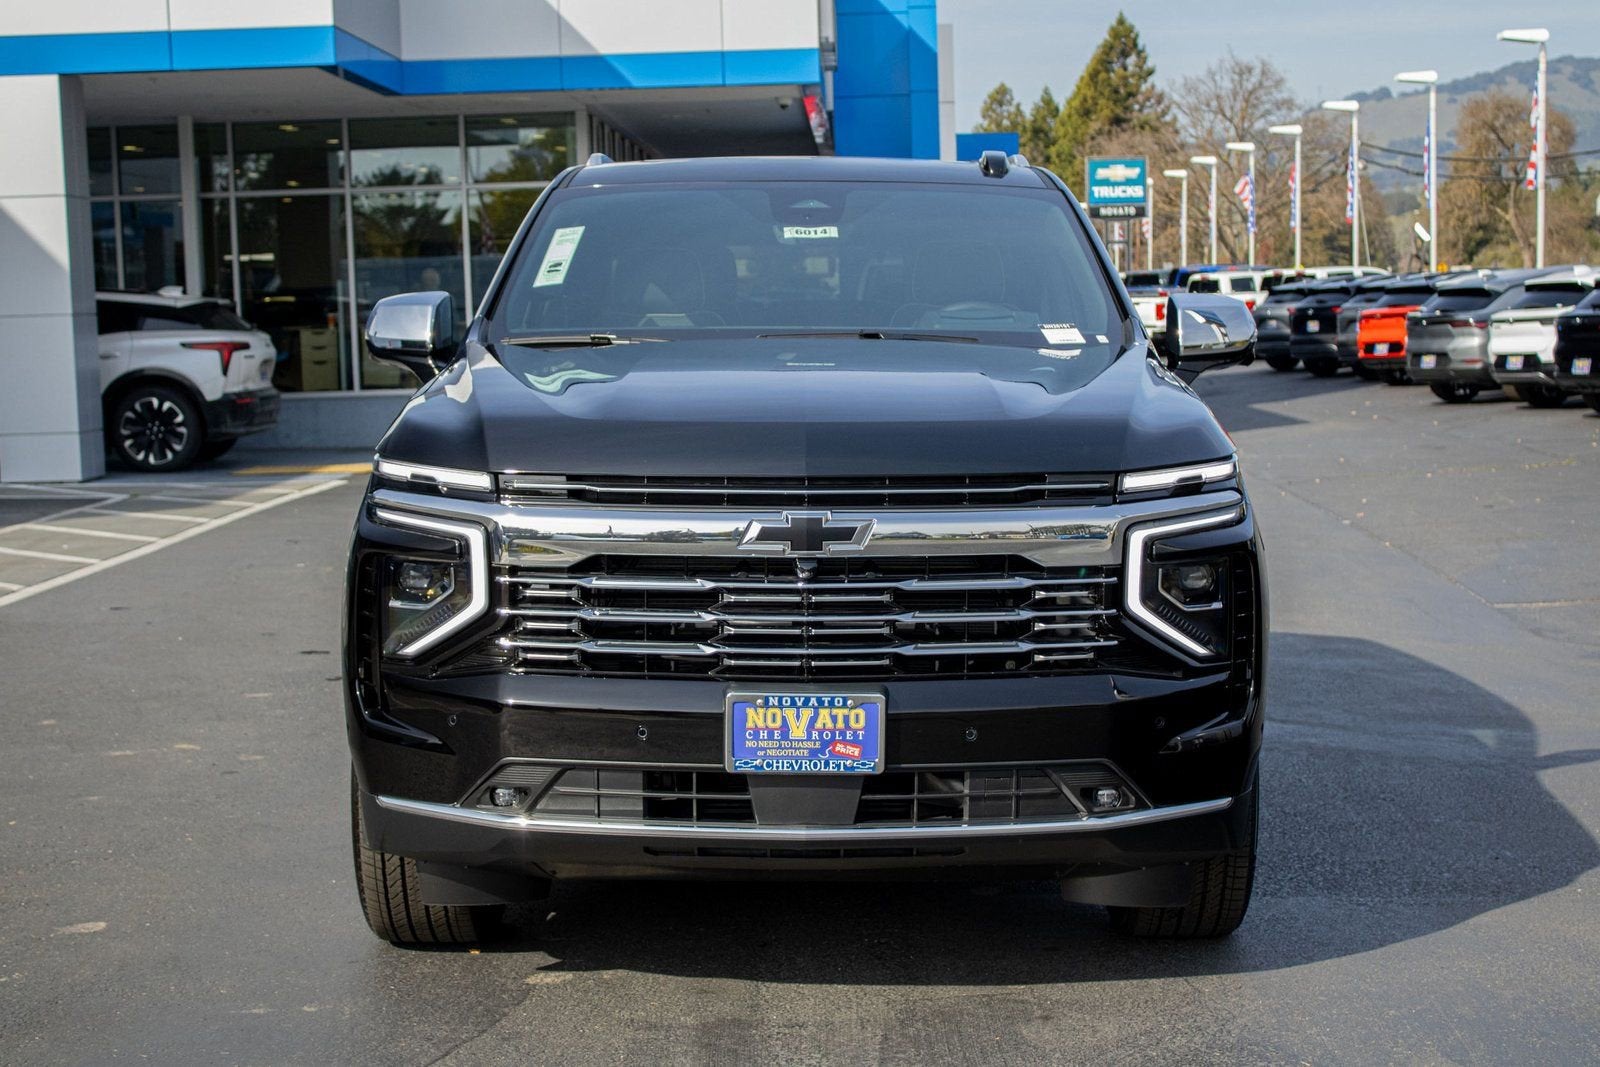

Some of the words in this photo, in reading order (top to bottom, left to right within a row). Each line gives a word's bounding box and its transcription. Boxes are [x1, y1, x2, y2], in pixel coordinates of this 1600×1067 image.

[1091, 185, 1144, 199] TRUCKS
[1099, 205, 1137, 217] NOVATO
[768, 696, 844, 707] NOVATO
[745, 707, 866, 739] NOVATO
[792, 741, 821, 749] HASSLE
[766, 749, 809, 757] NEGOTIATE
[835, 746, 860, 757] PRICE
[763, 759, 847, 772] CHEVROLET
